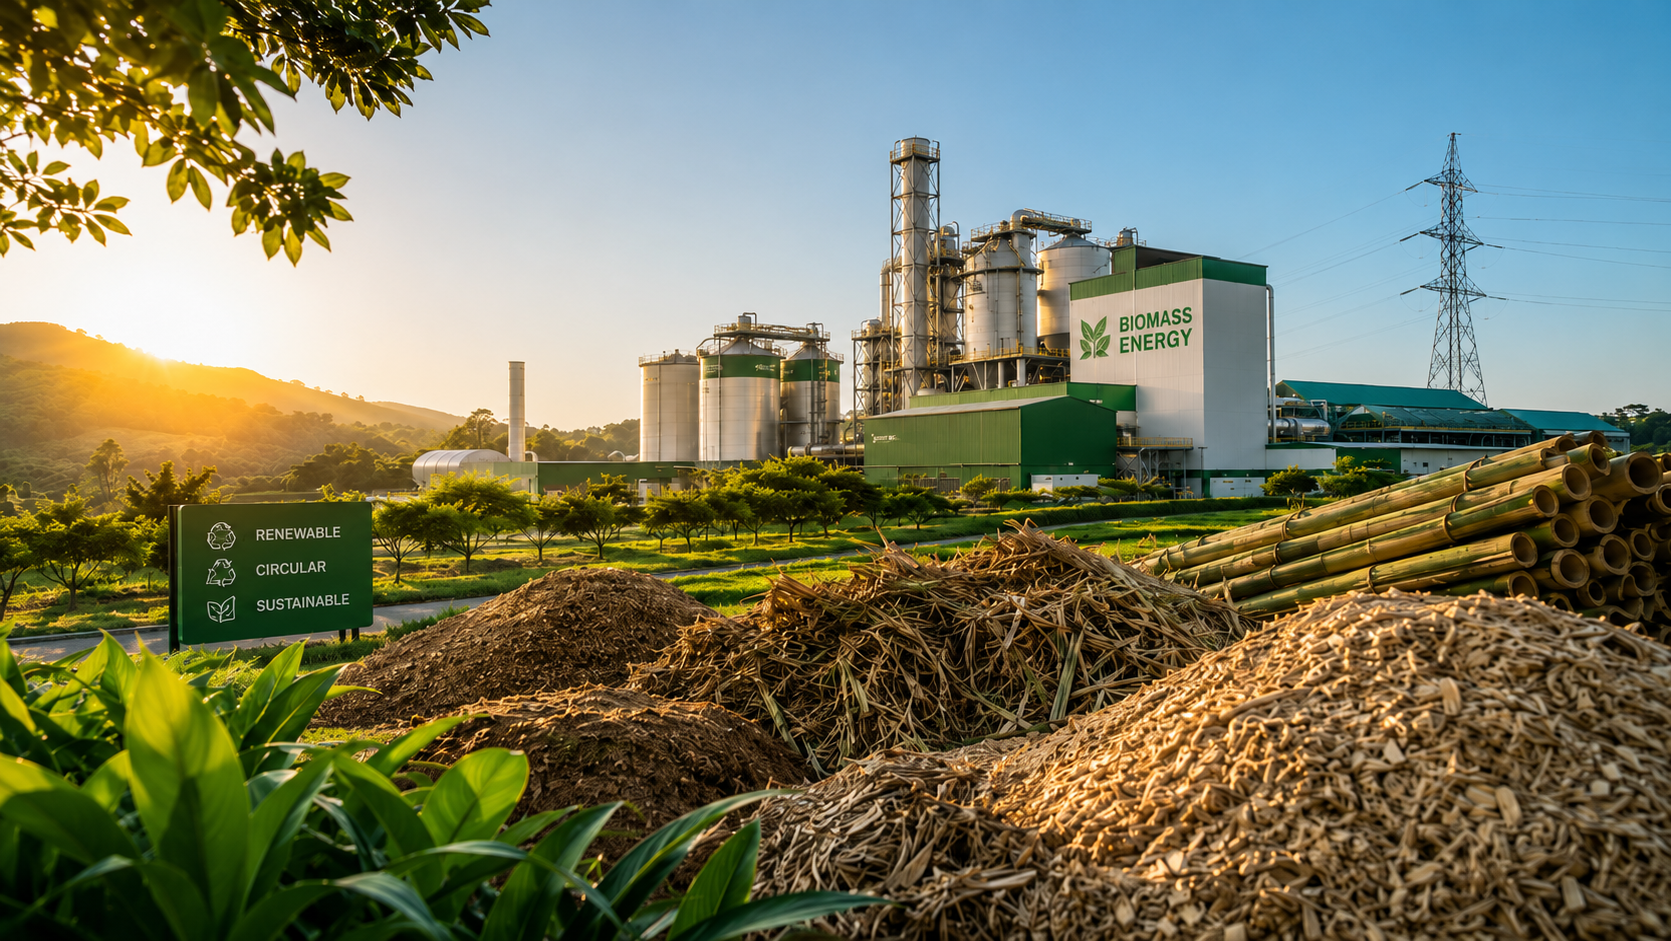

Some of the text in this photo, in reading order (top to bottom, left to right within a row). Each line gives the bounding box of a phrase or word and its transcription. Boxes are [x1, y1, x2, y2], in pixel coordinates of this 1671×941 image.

[1120, 307, 1192, 333] BIOMASS
[1120, 328, 1192, 354] ENERGY
[256, 526, 341, 541] RENEWABLE
[256, 560, 326, 576] CIRCULAR
[256, 593, 350, 612] SUSTAINABLE
